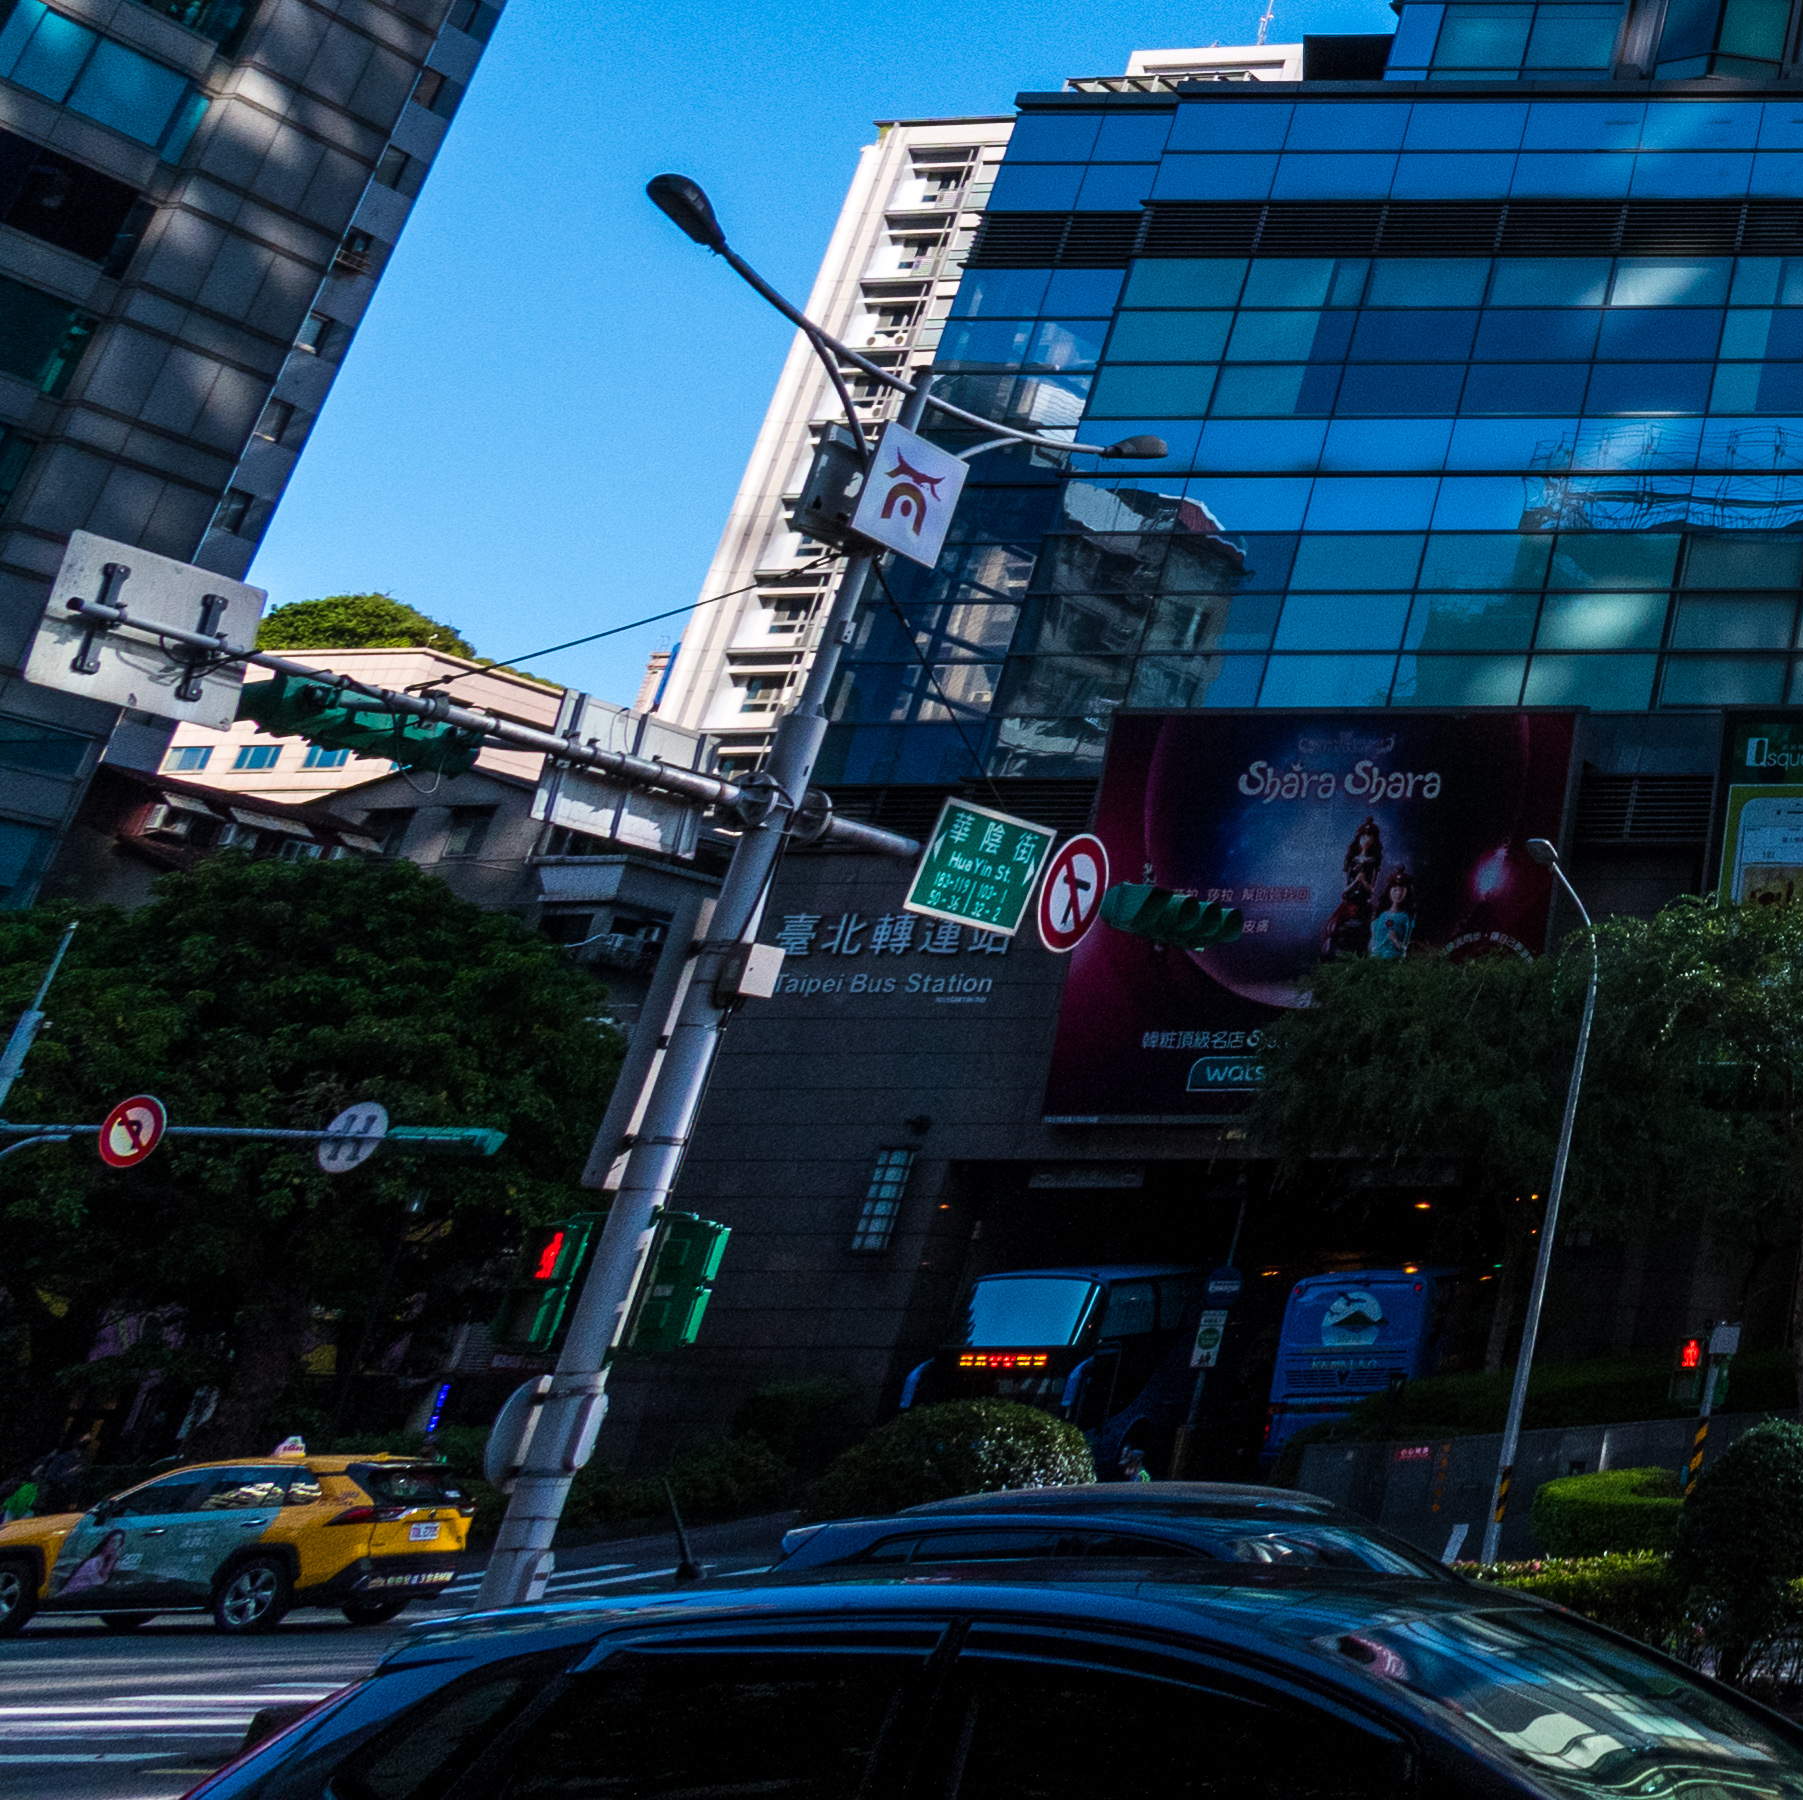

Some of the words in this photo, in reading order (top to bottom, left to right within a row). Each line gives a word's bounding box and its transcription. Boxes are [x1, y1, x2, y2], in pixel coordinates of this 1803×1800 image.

[1238, 758, 1338, 805] Shara
[1344, 758, 1443, 805] Shara
[949, 811, 1040, 865] 華陰街
[775, 911, 1010, 957] 臺北轉運站
[775, 973, 845, 997] Taipei
[849, 973, 897, 994] Bus
[904, 972, 993, 994] Station
